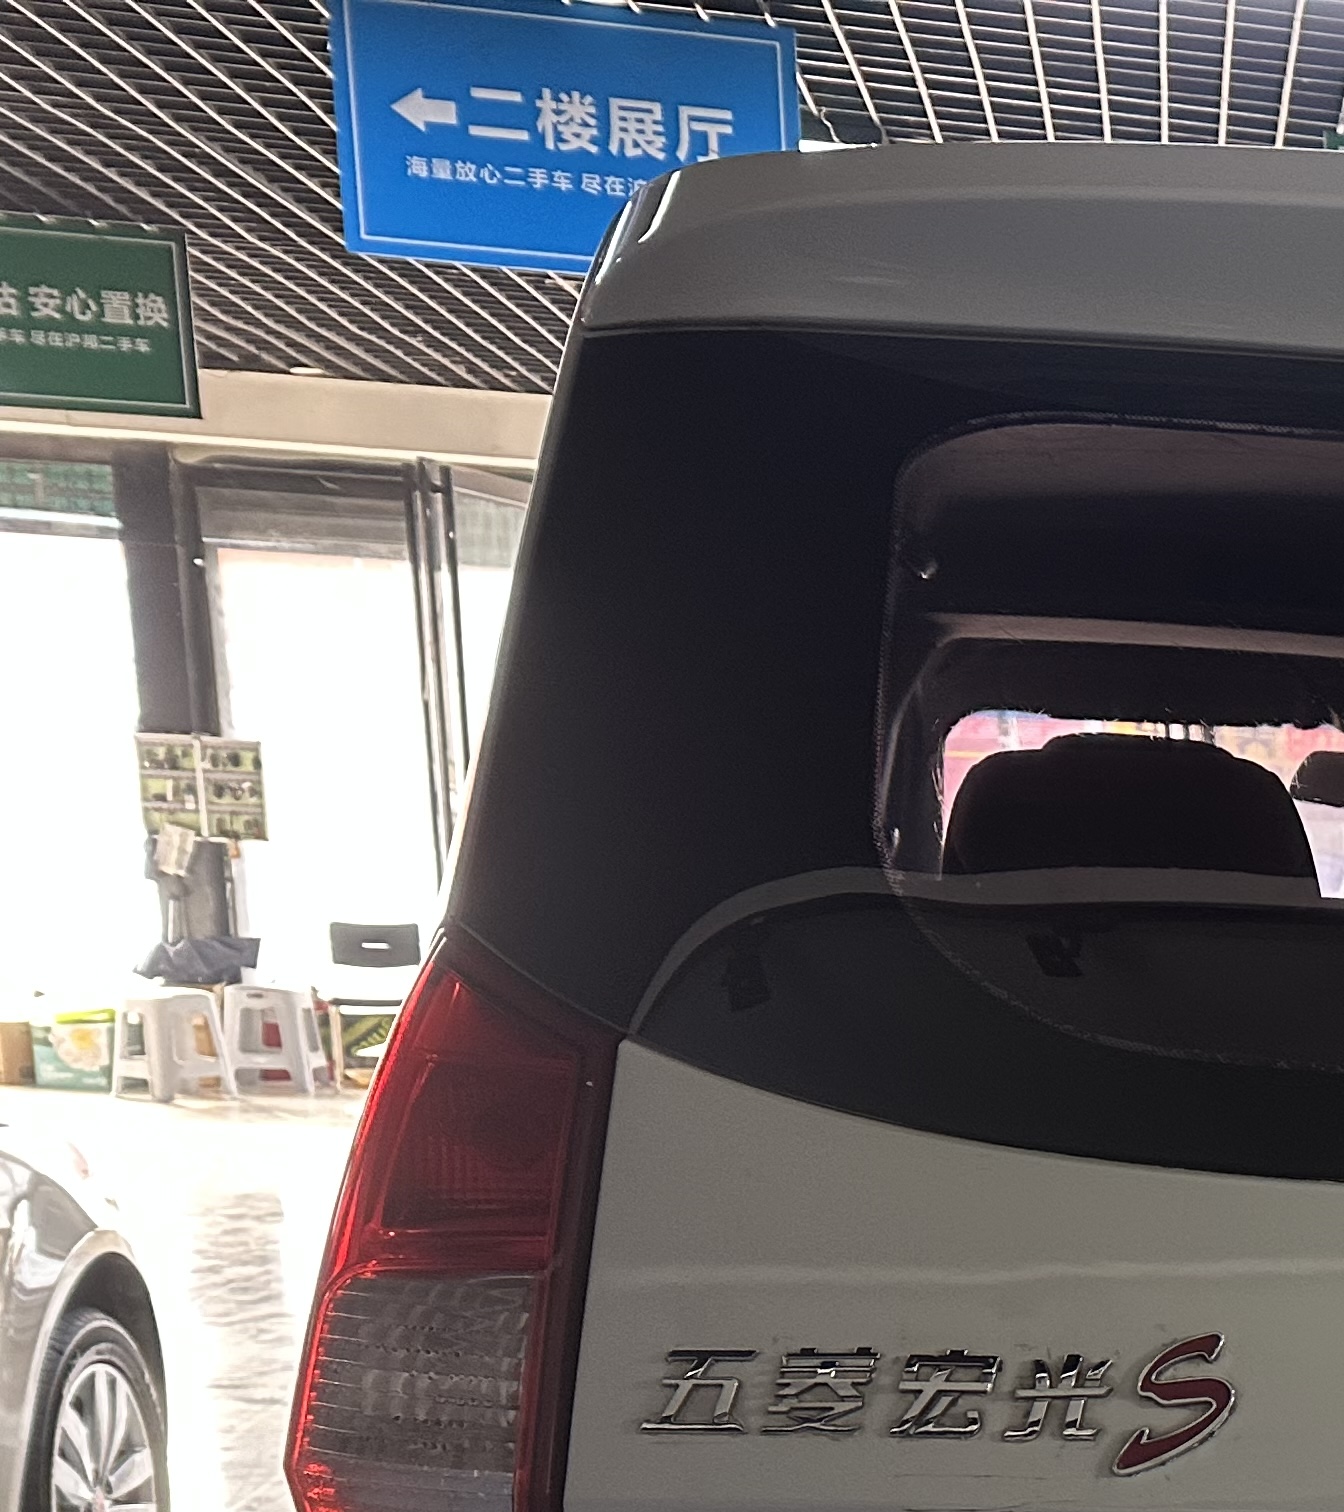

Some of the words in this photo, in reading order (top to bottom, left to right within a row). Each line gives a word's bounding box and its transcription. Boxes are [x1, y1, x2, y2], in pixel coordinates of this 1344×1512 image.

[468, 85, 734, 163] 二楼展厅
[405, 155, 574, 191] 海量放心二手车
[28, 284, 170, 329] 安心置换
[640, 1331, 1236, 1476] 五菱宏光S
